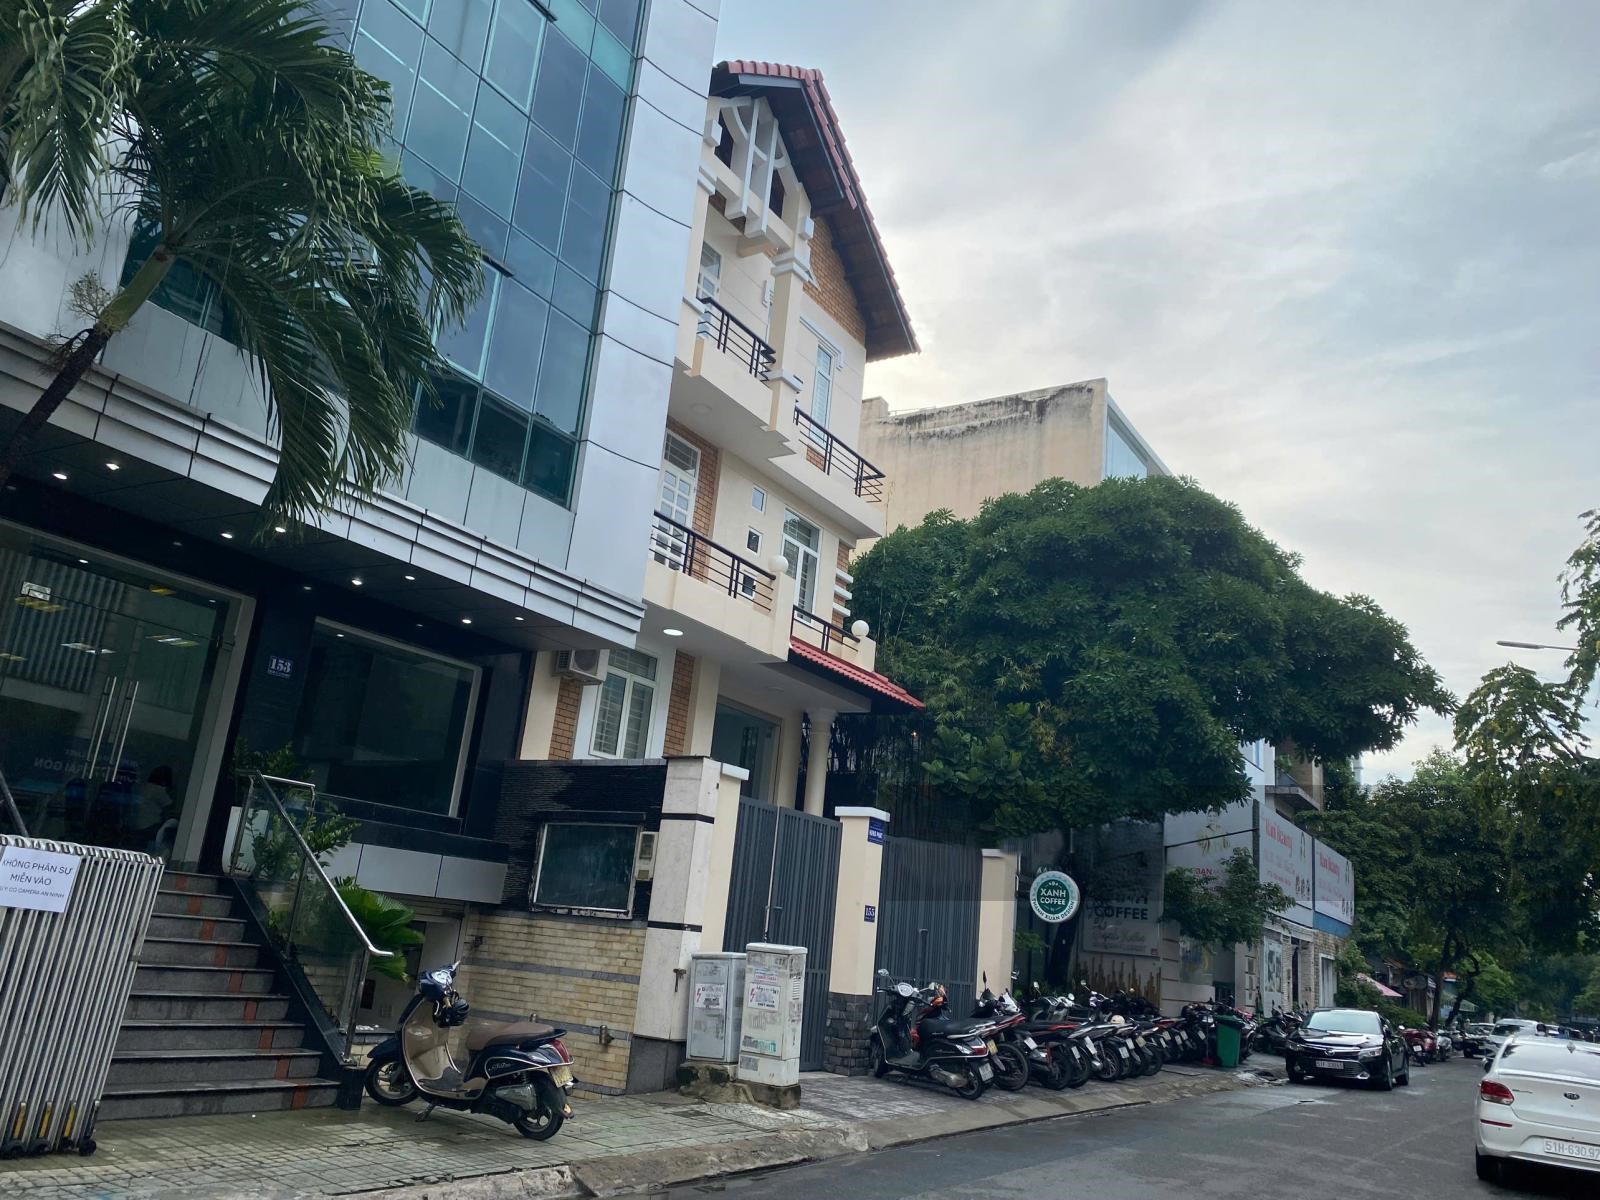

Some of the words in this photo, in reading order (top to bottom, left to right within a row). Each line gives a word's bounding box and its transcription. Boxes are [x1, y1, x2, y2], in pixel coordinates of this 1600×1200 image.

[271, 659, 291, 673] 153
[1040, 888, 1066, 897] XANH
[1040, 897, 1066, 905] COFFEE
[865, 907, 875, 917] 155
[1060, 900, 1075, 919] DESIGN
[1094, 906, 1148, 921] COFFEE
